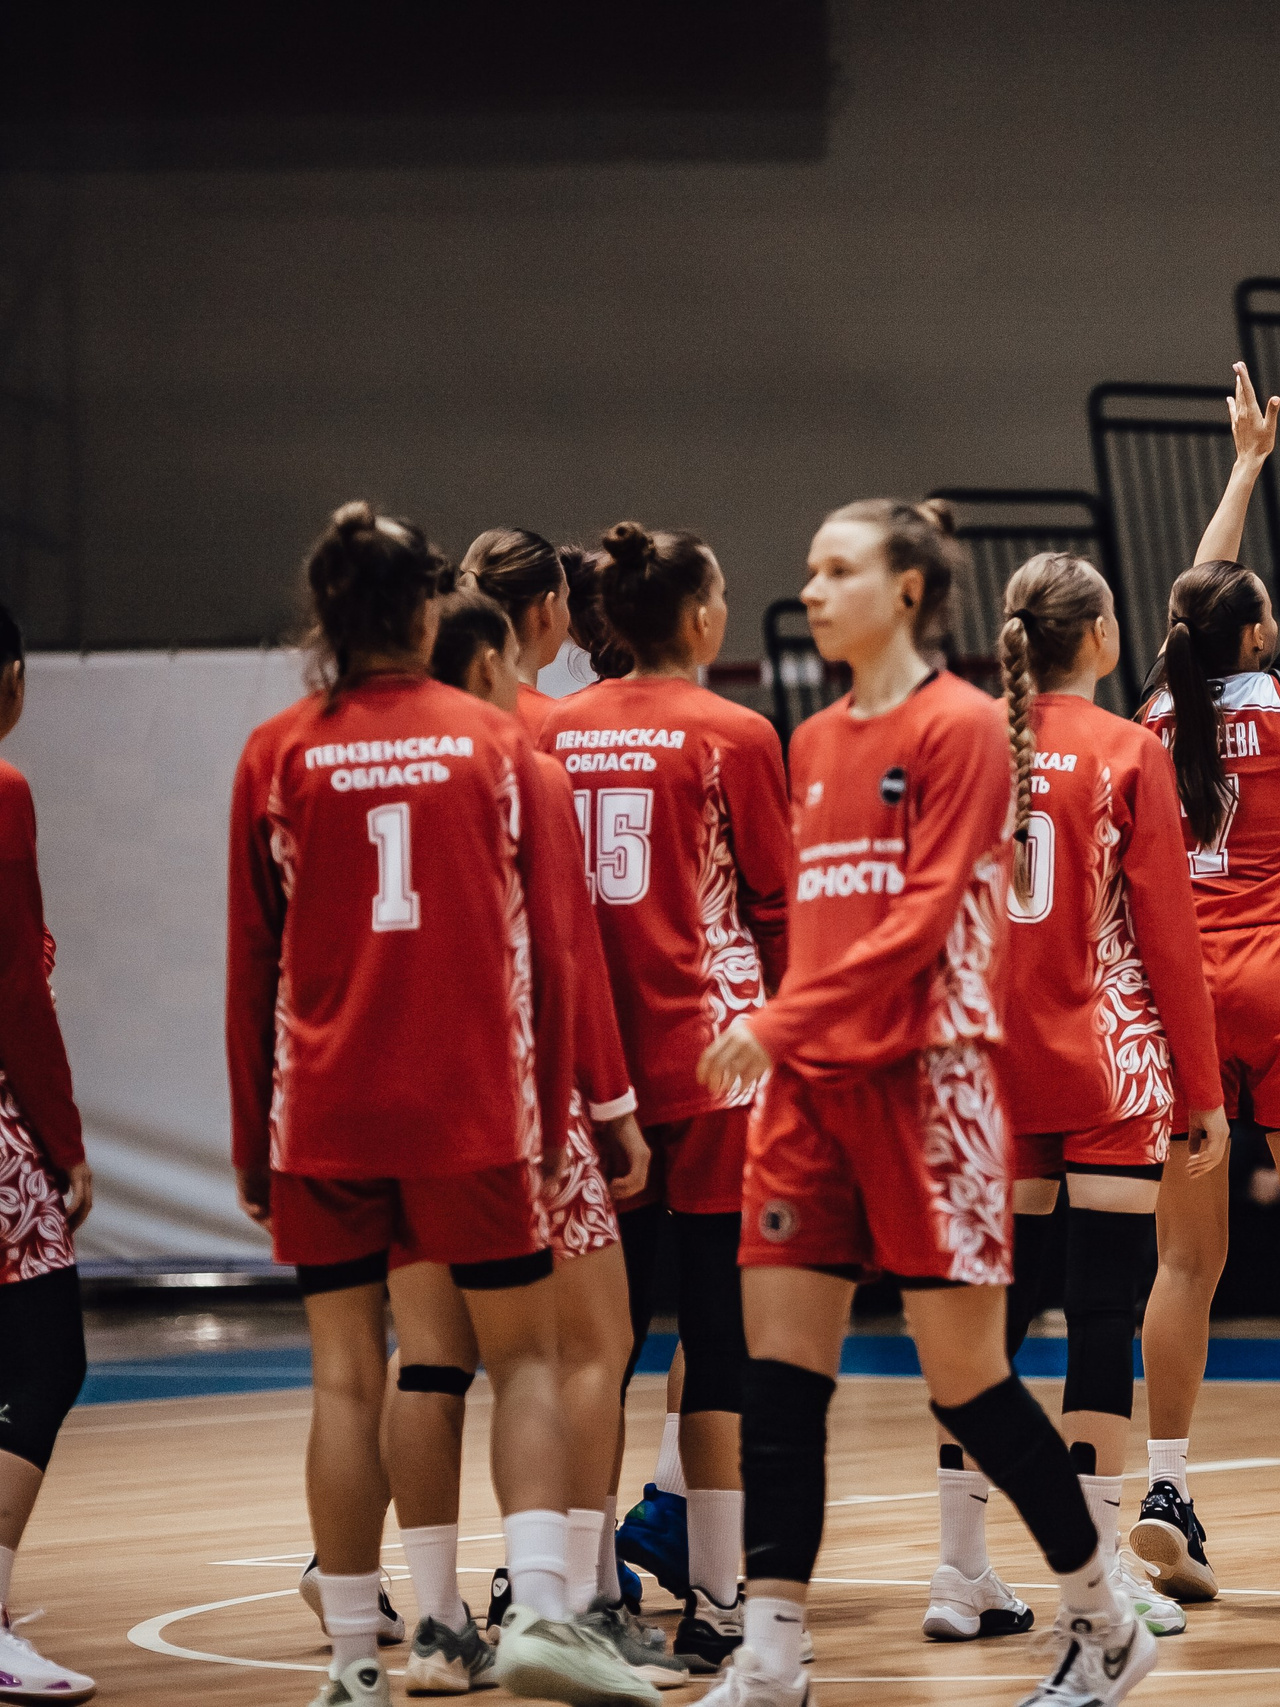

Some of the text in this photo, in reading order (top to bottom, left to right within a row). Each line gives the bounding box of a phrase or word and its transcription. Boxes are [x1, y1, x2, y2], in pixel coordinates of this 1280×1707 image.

[304, 735, 474, 770] ПЕНЗЕНСКАЯ
[556, 728, 686, 750] ПЕНЗЕНСКАЯ
[330, 761, 451, 792] ОБЛАСТЬ
[565, 752, 657, 773] ОБЛАСТЬ
[367, 802, 421, 933] 1
